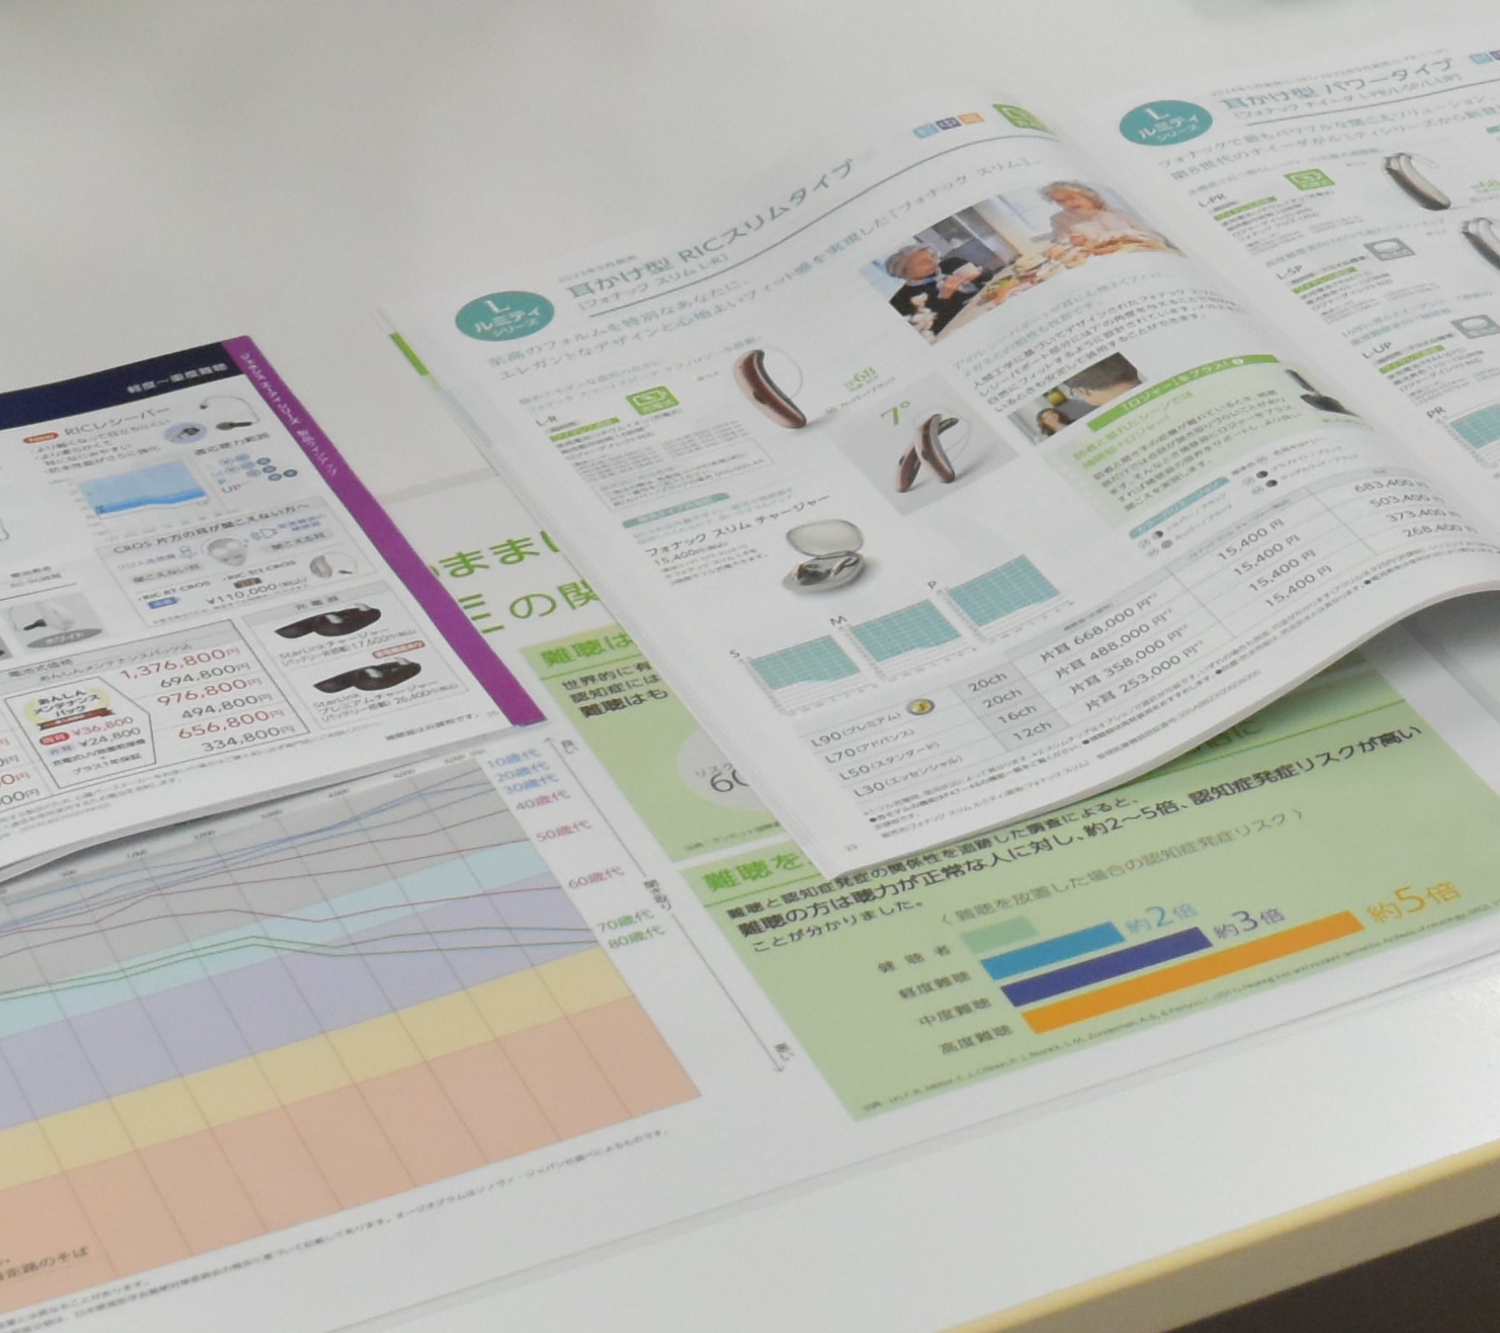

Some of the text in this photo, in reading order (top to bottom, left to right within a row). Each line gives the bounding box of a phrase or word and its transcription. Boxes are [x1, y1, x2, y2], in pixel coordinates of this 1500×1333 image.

[1219, 58, 1454, 110] 耳かけ型 パワータイプ
[566, 158, 854, 298] 耳かけ型 RICスリムタイプ
[645, 495, 829, 557] フォナック スリム チャージャー
[1218, 527, 1268, 561] 15,400
[1234, 542, 1284, 576] 15,400
[1249, 558, 1300, 592] 15,400
[1265, 574, 1316, 608] 15,400
[1040, 607, 1135, 664] 片耳 668,000
[1055, 623, 1151, 679] 片耳 488,000
[120, 646, 241, 682] 1,376,800円
[160, 661, 252, 689] 694,800円
[1070, 638, 1166, 696] 片耳 358,000
[158, 676, 262, 707] 976,800円
[967, 671, 1008, 693] 20ch
[1085, 654, 1182, 712] 片耳 253,000
[182, 692, 273, 720] 494,800円
[982, 687, 1023, 709] 20ch
[72, 716, 134, 738] ¥36,800
[178, 708, 285, 741] 656,800円
[998, 704, 1037, 724] 16ch
[79, 727, 141, 749] ¥24,800
[202, 724, 296, 753] 334,800円
[1012, 720, 1052, 741] 12ch
[487, 748, 540, 769] 10歳代
[497, 761, 551, 783] 20歳代
[505, 773, 559, 795] 30歳代
[516, 789, 570, 811] 40歳代
[536, 819, 592, 842] 50歳代
[568, 865, 625, 889] 60歳代
[702, 851, 804, 893] 難聴を
[1368, 880, 1462, 924] 約5倍
[596, 908, 654, 933] 70歳代
[753, 900, 925, 953] ことが分かりました。
[1125, 903, 1198, 934] 約2倍
[1213, 907, 1286, 940] 約3倍
[608, 924, 665, 949] 80歳代
[898, 970, 973, 1001] 軽度難聴
[918, 997, 993, 1027] 中度難聴
[939, 1023, 1014, 1056] 高度難聴
